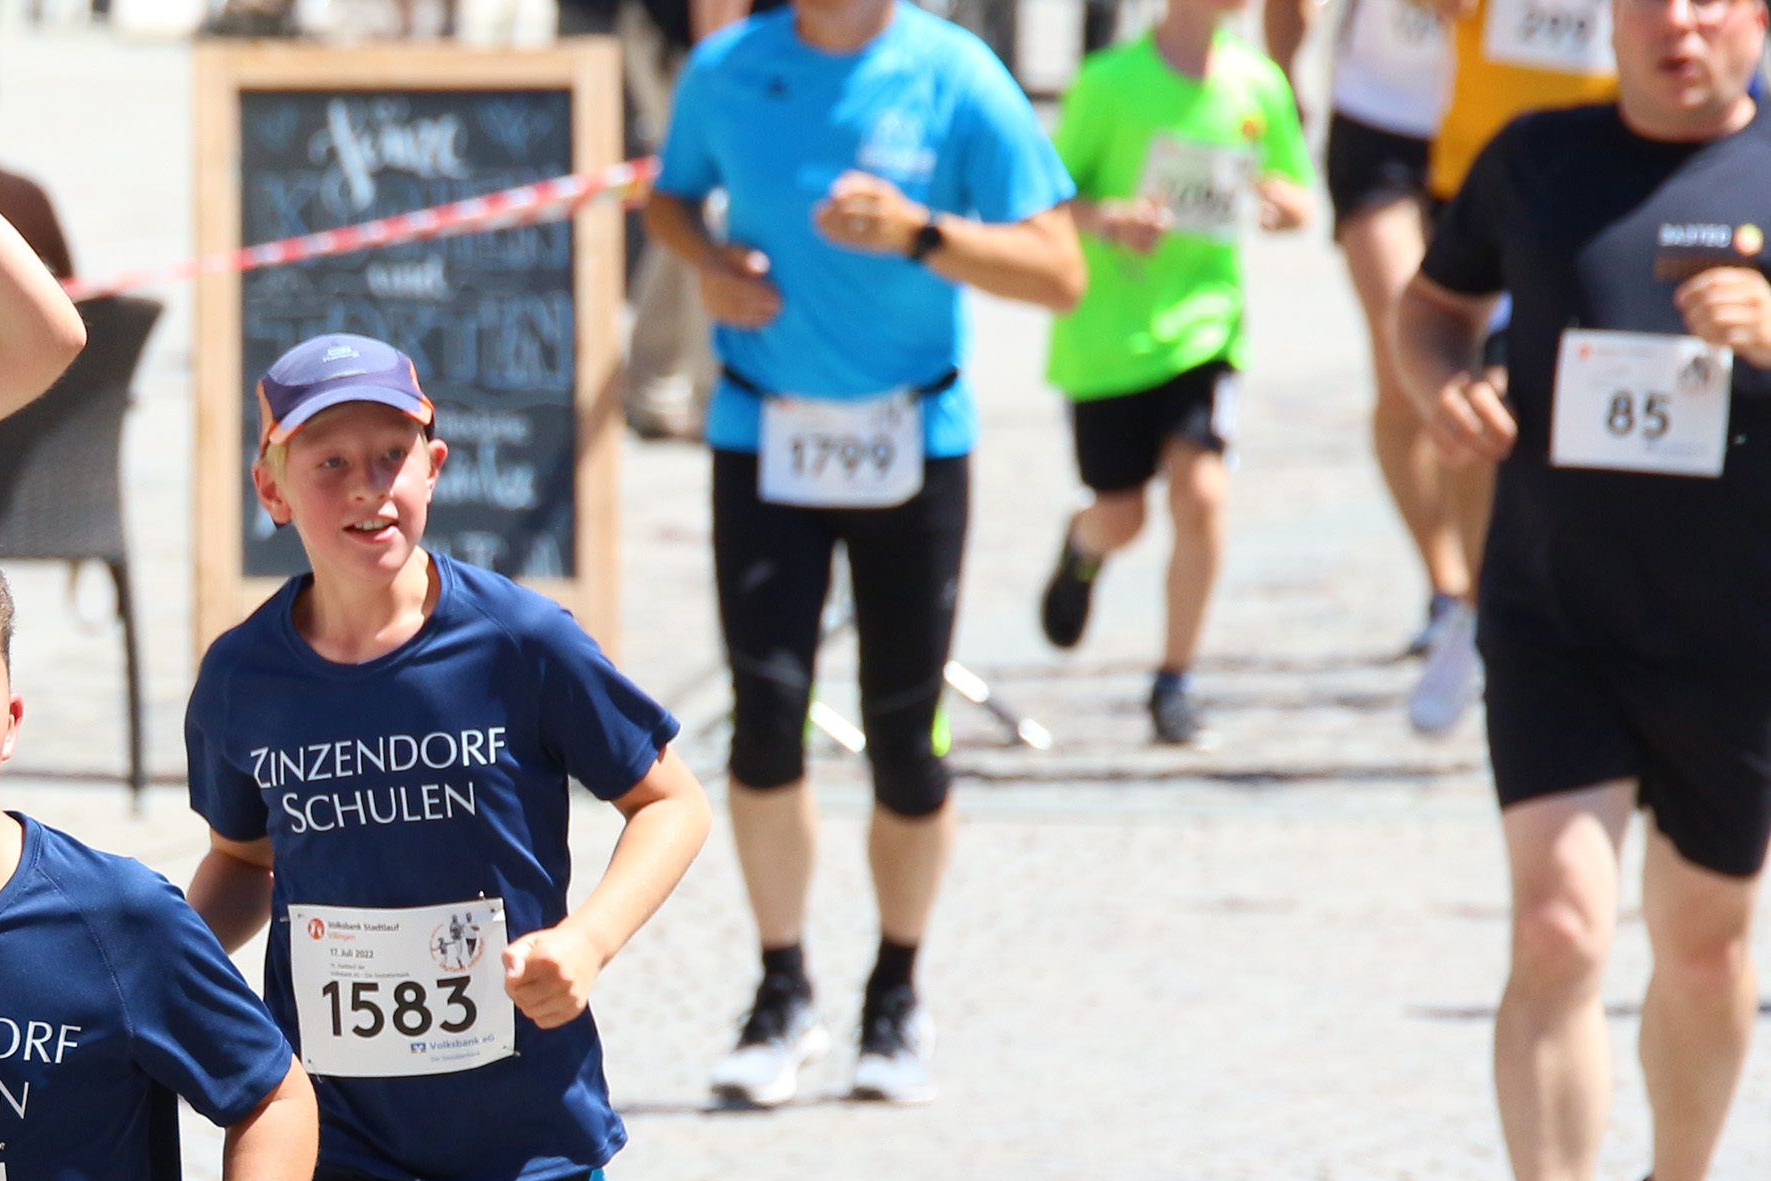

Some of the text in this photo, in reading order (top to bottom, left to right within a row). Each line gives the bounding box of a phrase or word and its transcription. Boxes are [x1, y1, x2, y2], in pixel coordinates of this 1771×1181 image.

[1606, 391, 1671, 438] 85
[787, 428, 896, 478] 1799
[250, 727, 506, 789] ZINZENDORF
[282, 781, 477, 834] SCHULEN
[328, 921, 399, 931] Volksbank Stadtlauf
[330, 948, 373, 959] 17. Juli 2022
[322, 975, 477, 1038] 1583
[430, 1037, 479, 1050] Volksbank
